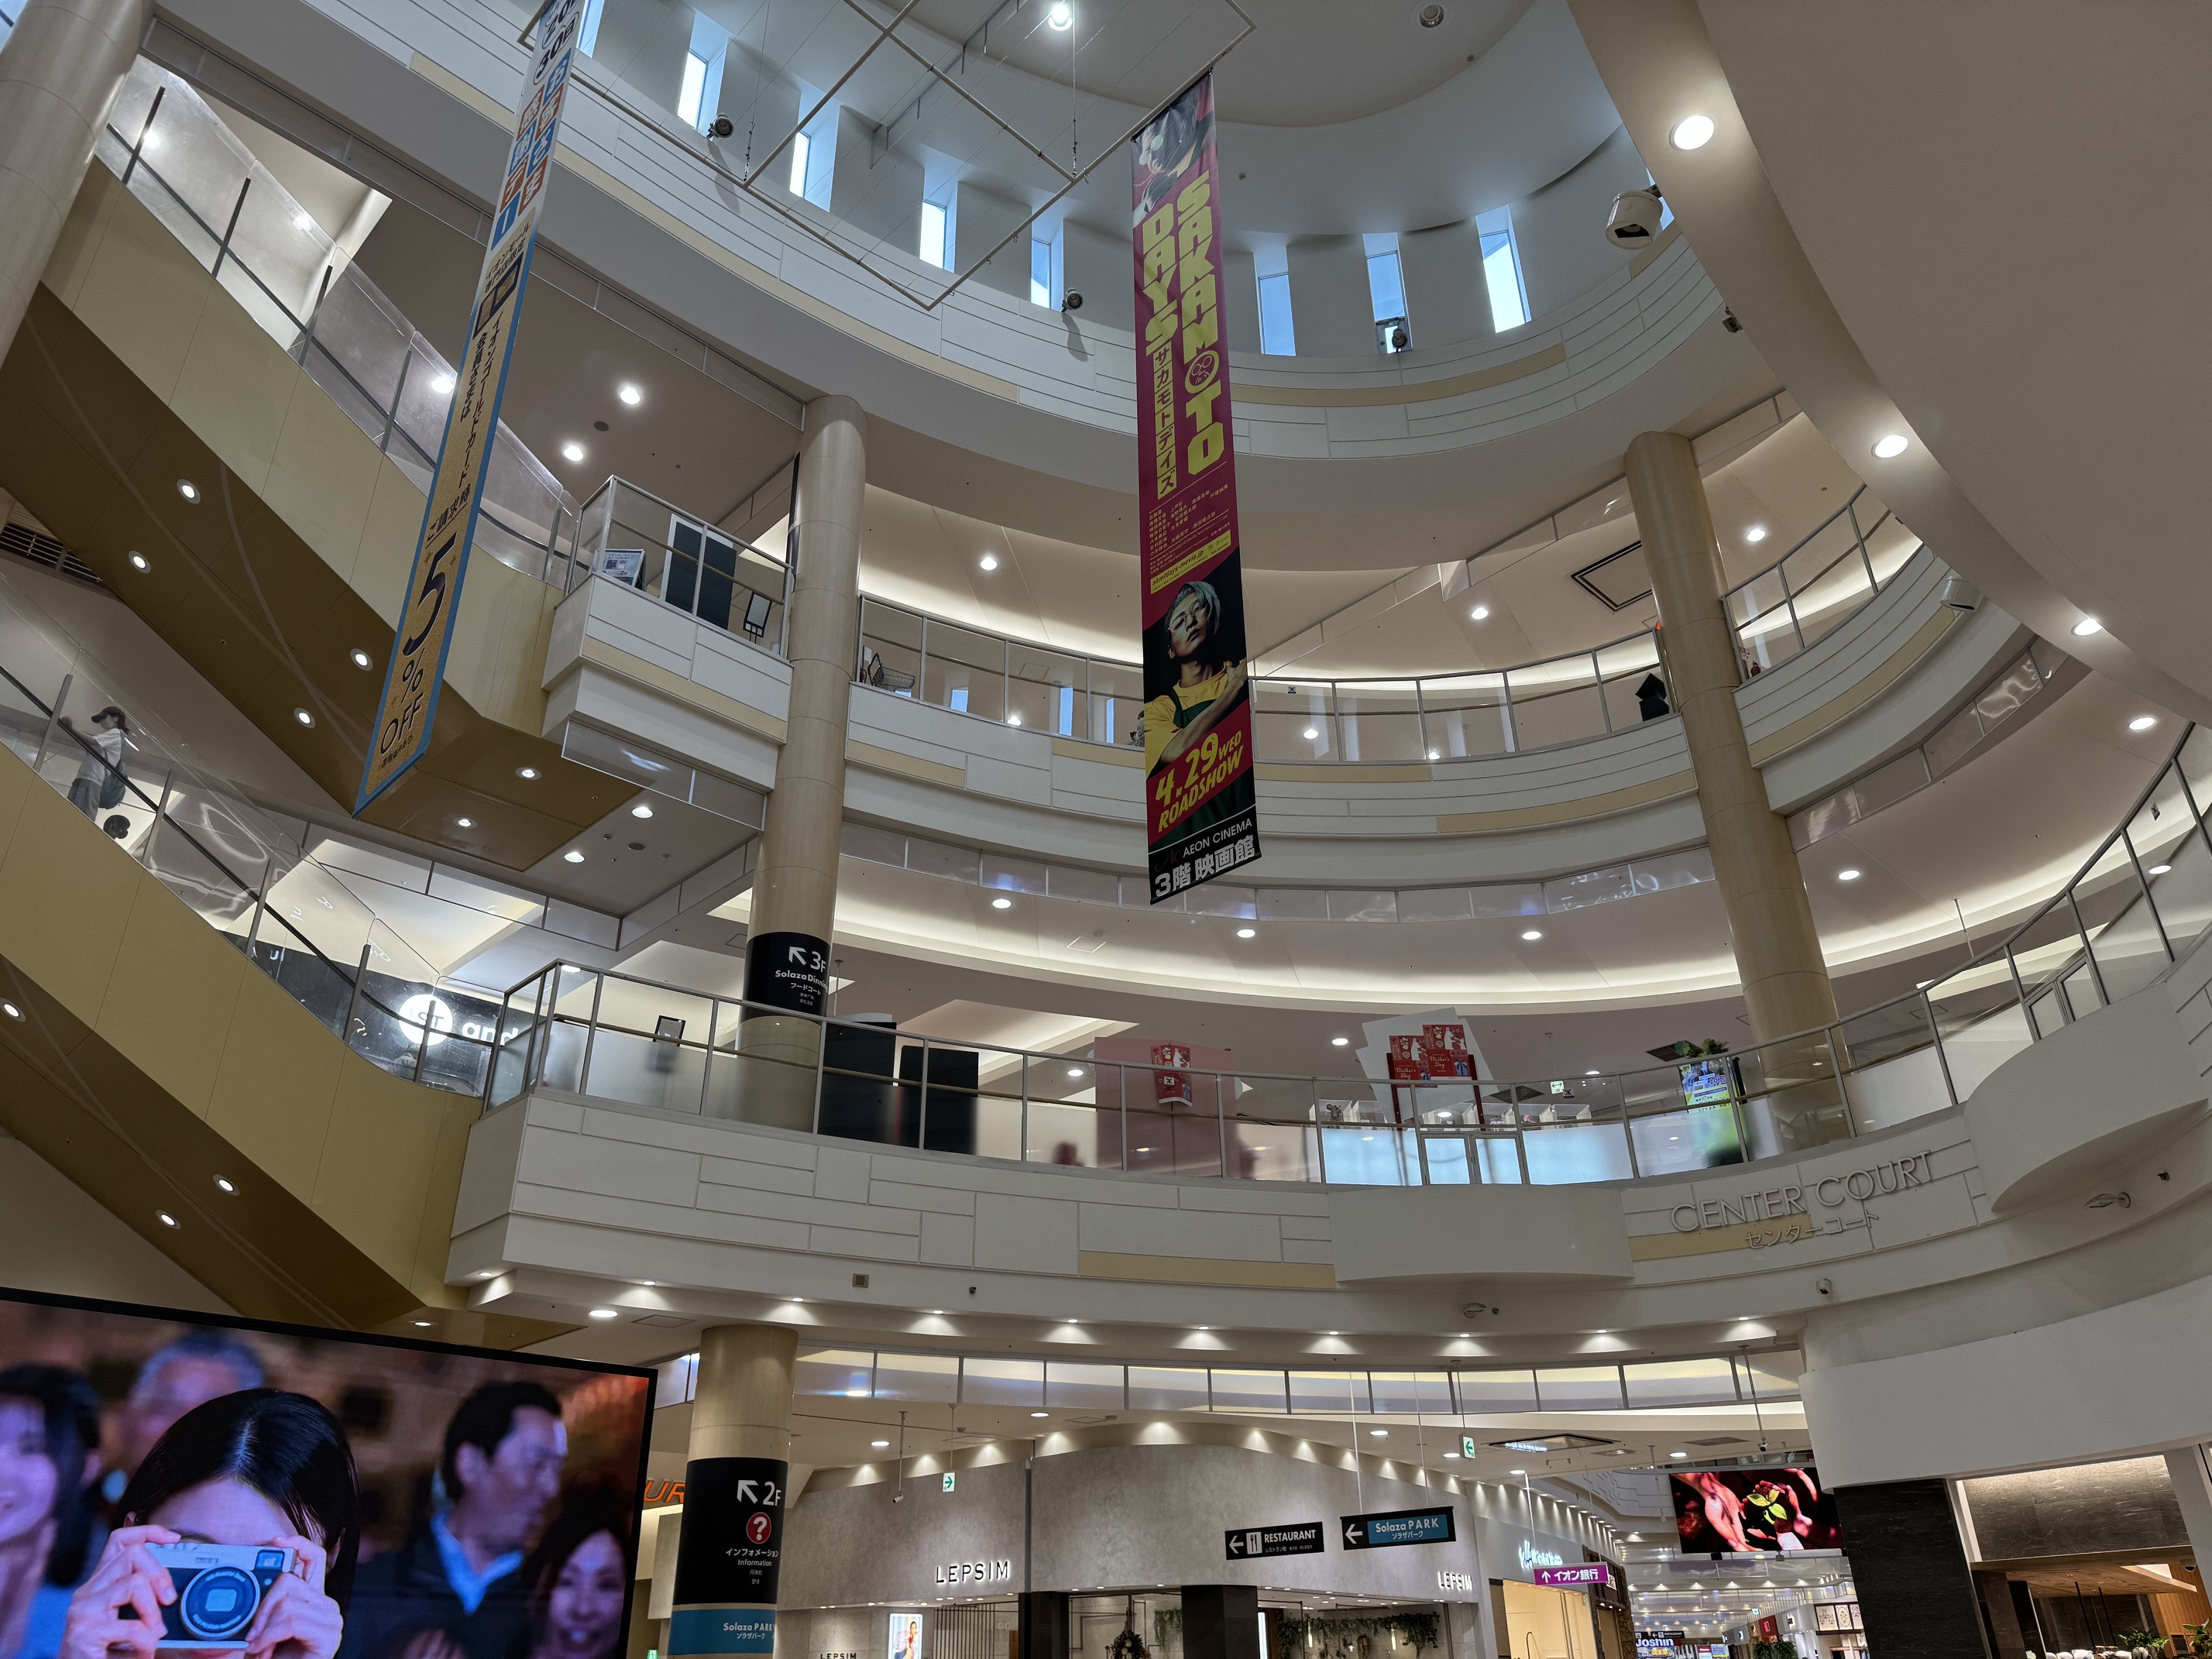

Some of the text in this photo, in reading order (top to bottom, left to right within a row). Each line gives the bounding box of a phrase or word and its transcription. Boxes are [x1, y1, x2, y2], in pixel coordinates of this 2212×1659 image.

[521, 56, 568, 209] お客さま
[500, 88, 543, 235] 感謝デー
[1142, 203, 1179, 356] DAYS
[459, 310, 503, 489] イオンゴールドカード
[460, 331, 487, 424] 会員さまは
[1153, 342, 1176, 500] サカモトデイズ
[428, 483, 471, 541] ご請求時
[380, 691, 424, 755] OFF
[1155, 730, 1242, 808] 4.29 WED
[1158, 744, 1244, 833] ROADSHOW
[1183, 818, 1252, 858] AEON CINEMA
[1155, 834, 1255, 898] 3階 映画館
[810, 950, 826, 973] 3F
[791, 982, 821, 995] フードコート
[1670, 1149, 1932, 1232] CENTER COURT
[1745, 1209, 1880, 1250] センターコート
[763, 1481, 781, 1506] 2F
[1265, 1529, 1316, 1543] RESTAURANT
[1376, 1518, 1439, 1533] Solaza PARK
[1392, 1530, 1424, 1540] ソラザパーク
[726, 1548, 779, 1558] インフォメーション
[936, 1561, 1008, 1584] LEPSIM
[1554, 1568, 1599, 1582] イオン銀行
[723, 1622, 752, 1631] Solaza
